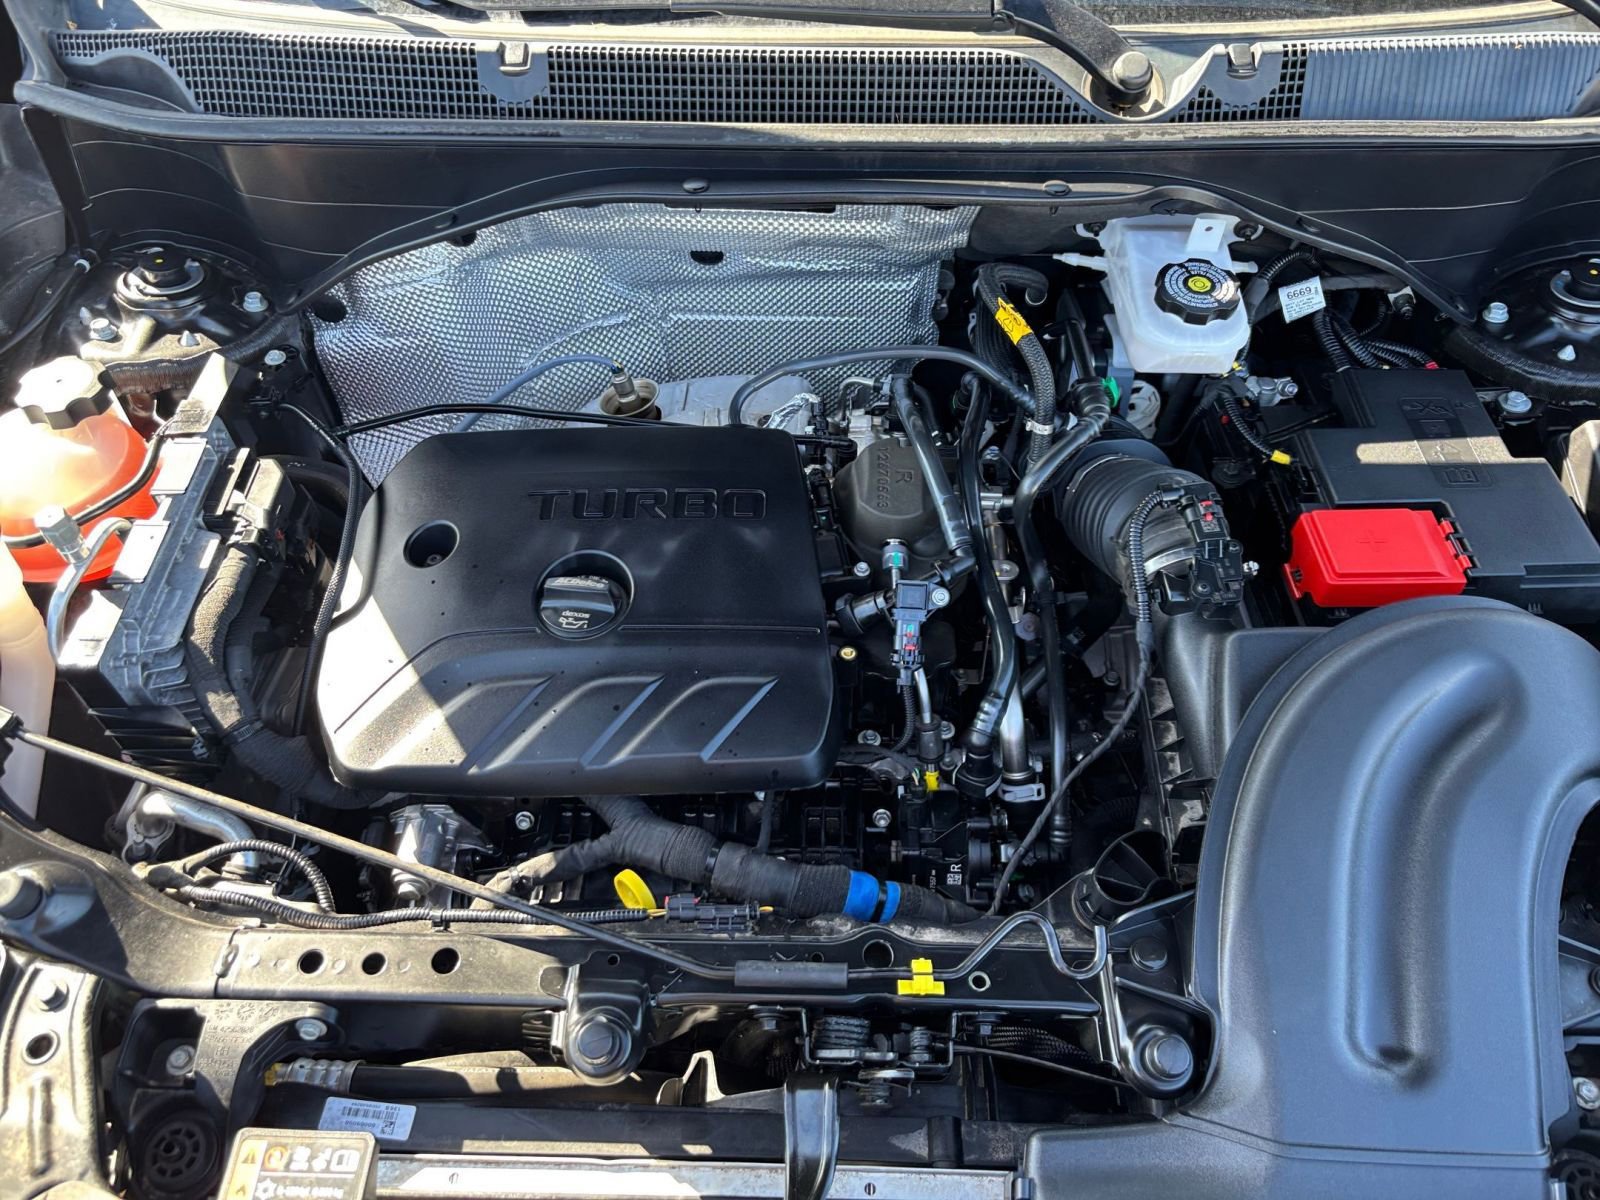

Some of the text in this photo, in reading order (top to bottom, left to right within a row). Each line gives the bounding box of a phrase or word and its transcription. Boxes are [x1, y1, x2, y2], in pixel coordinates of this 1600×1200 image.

[1286, 286, 1312, 299] 6669
[896, 469, 914, 484] R
[527, 488, 767, 521] TURBO
[554, 577, 605, 588] ACDelco
[562, 610, 591, 619] dexos
[950, 864, 962, 872] R
